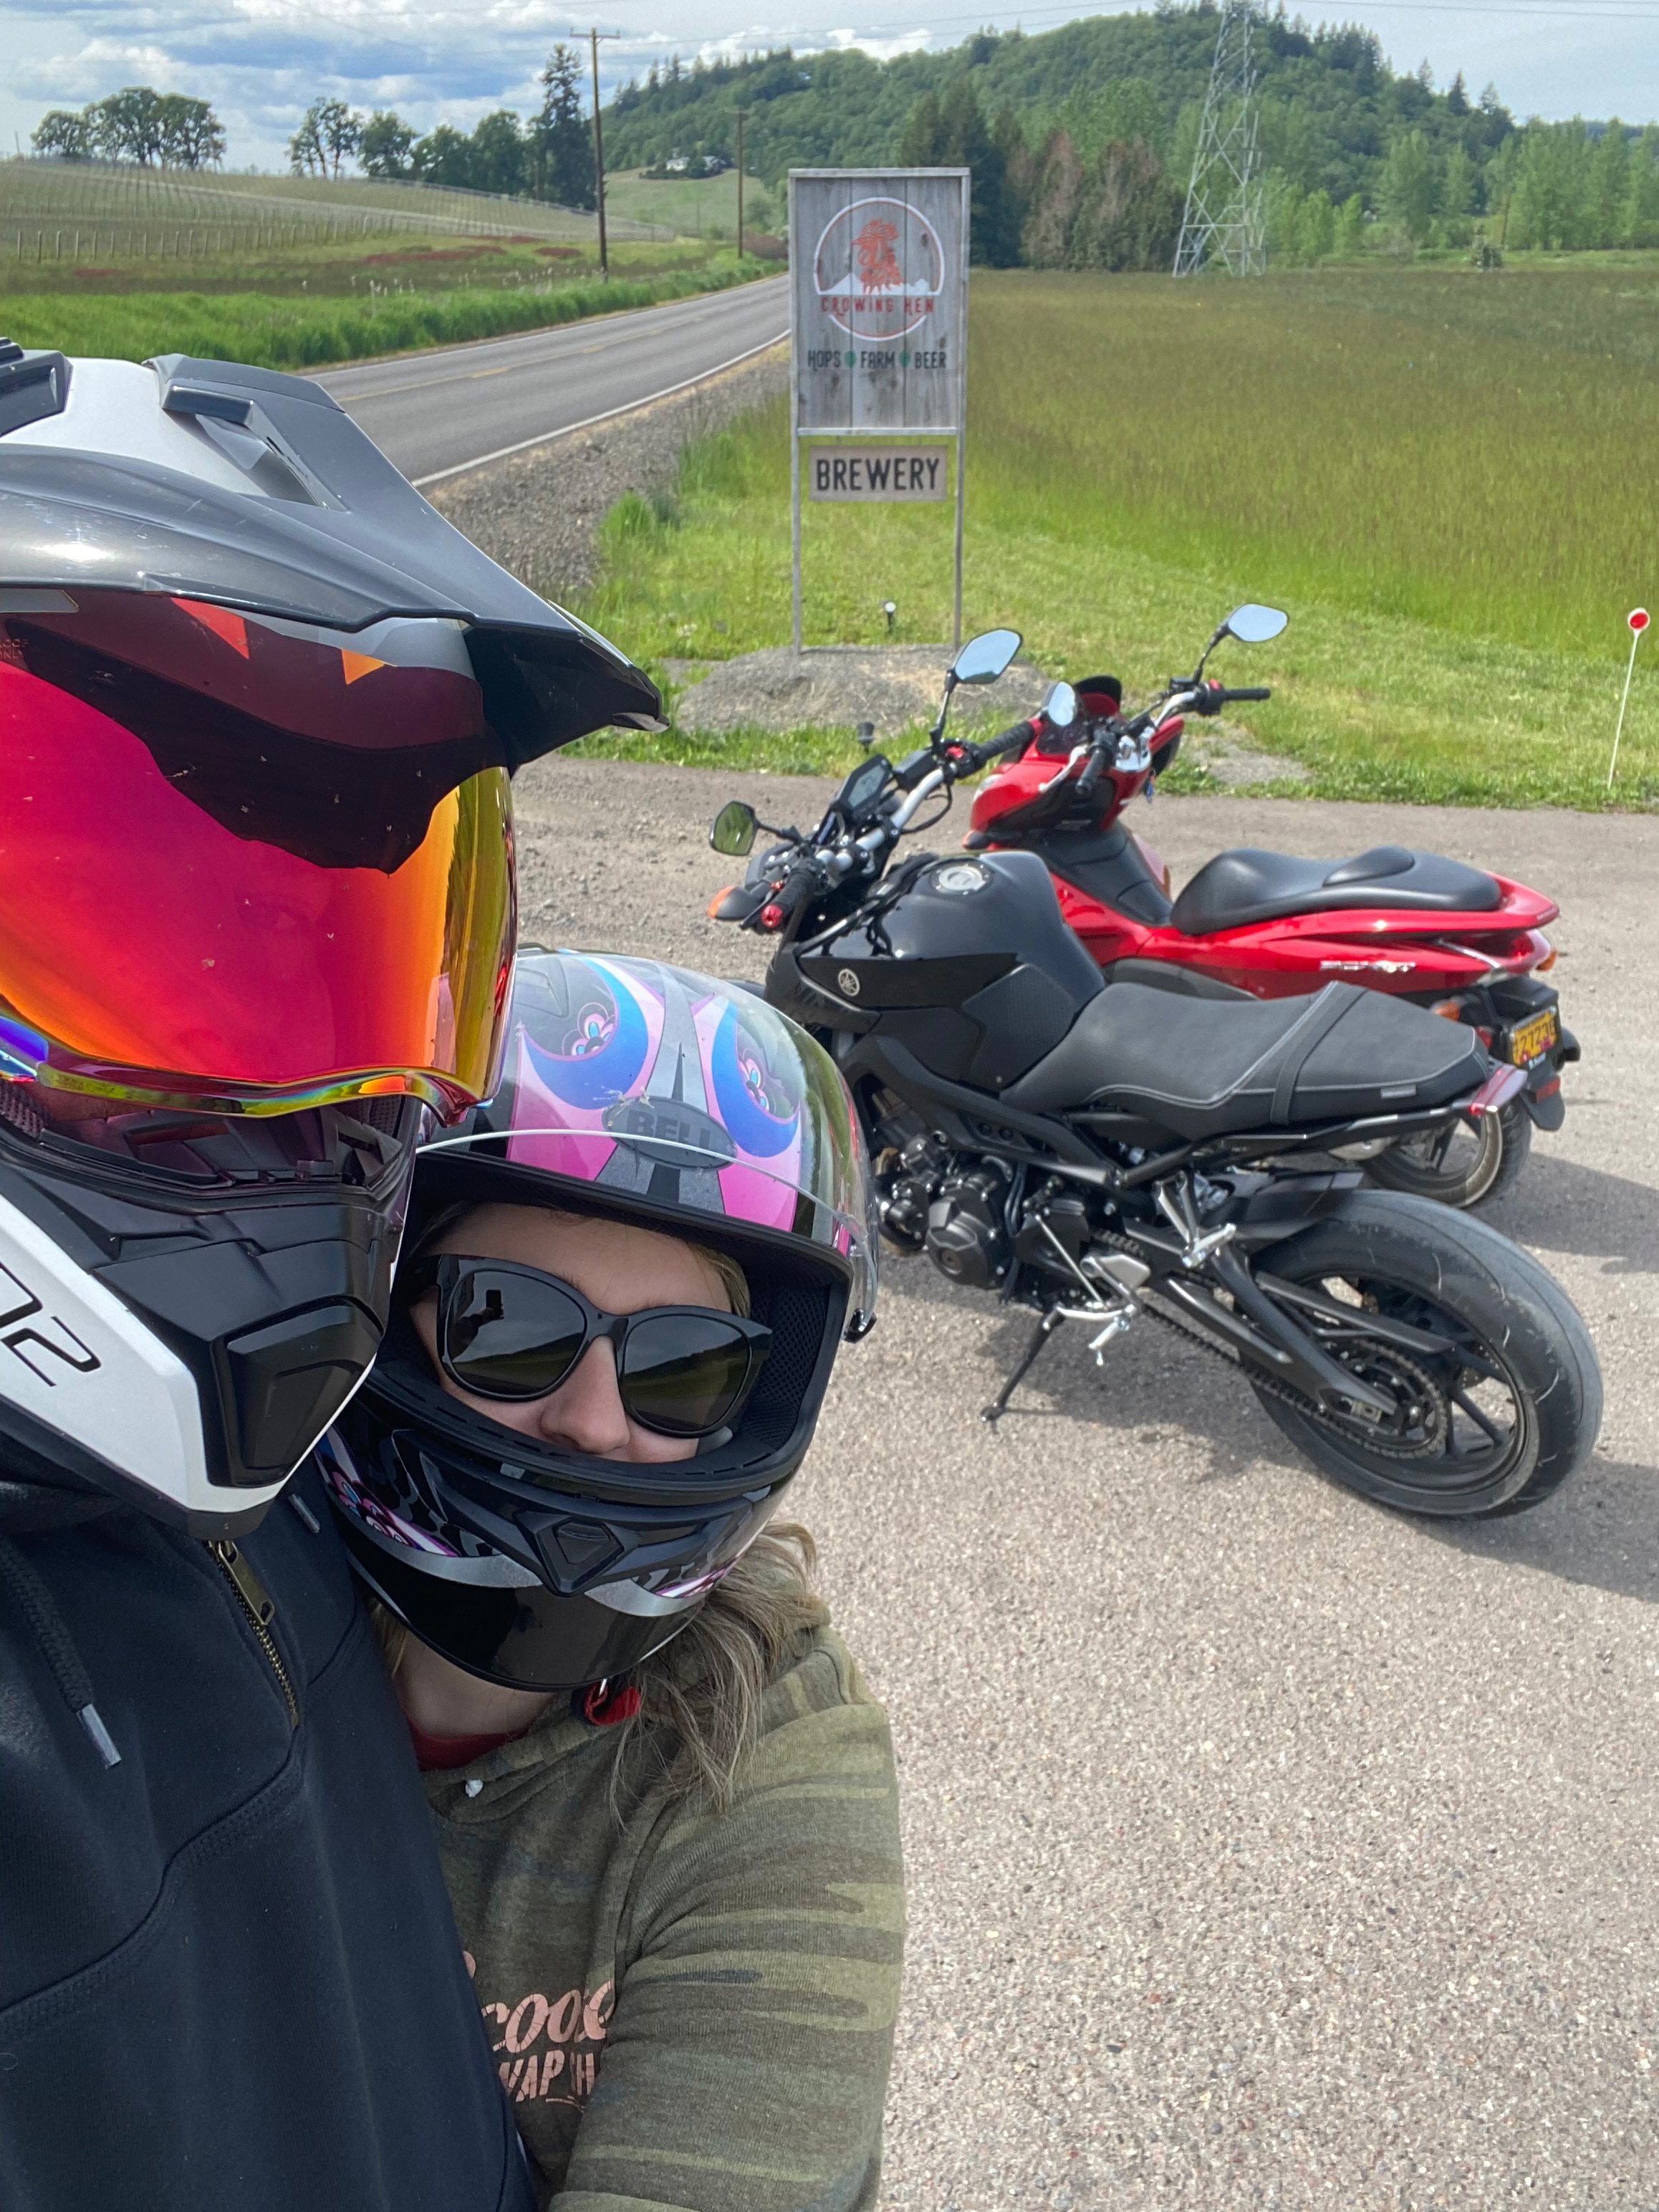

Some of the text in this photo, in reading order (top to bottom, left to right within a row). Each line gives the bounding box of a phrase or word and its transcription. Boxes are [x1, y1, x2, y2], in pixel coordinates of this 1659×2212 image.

[821, 296, 934, 317] CROWING HEN
[807, 350, 947, 372] HOPS FARM BEER
[816, 458, 940, 491] BREWERY
